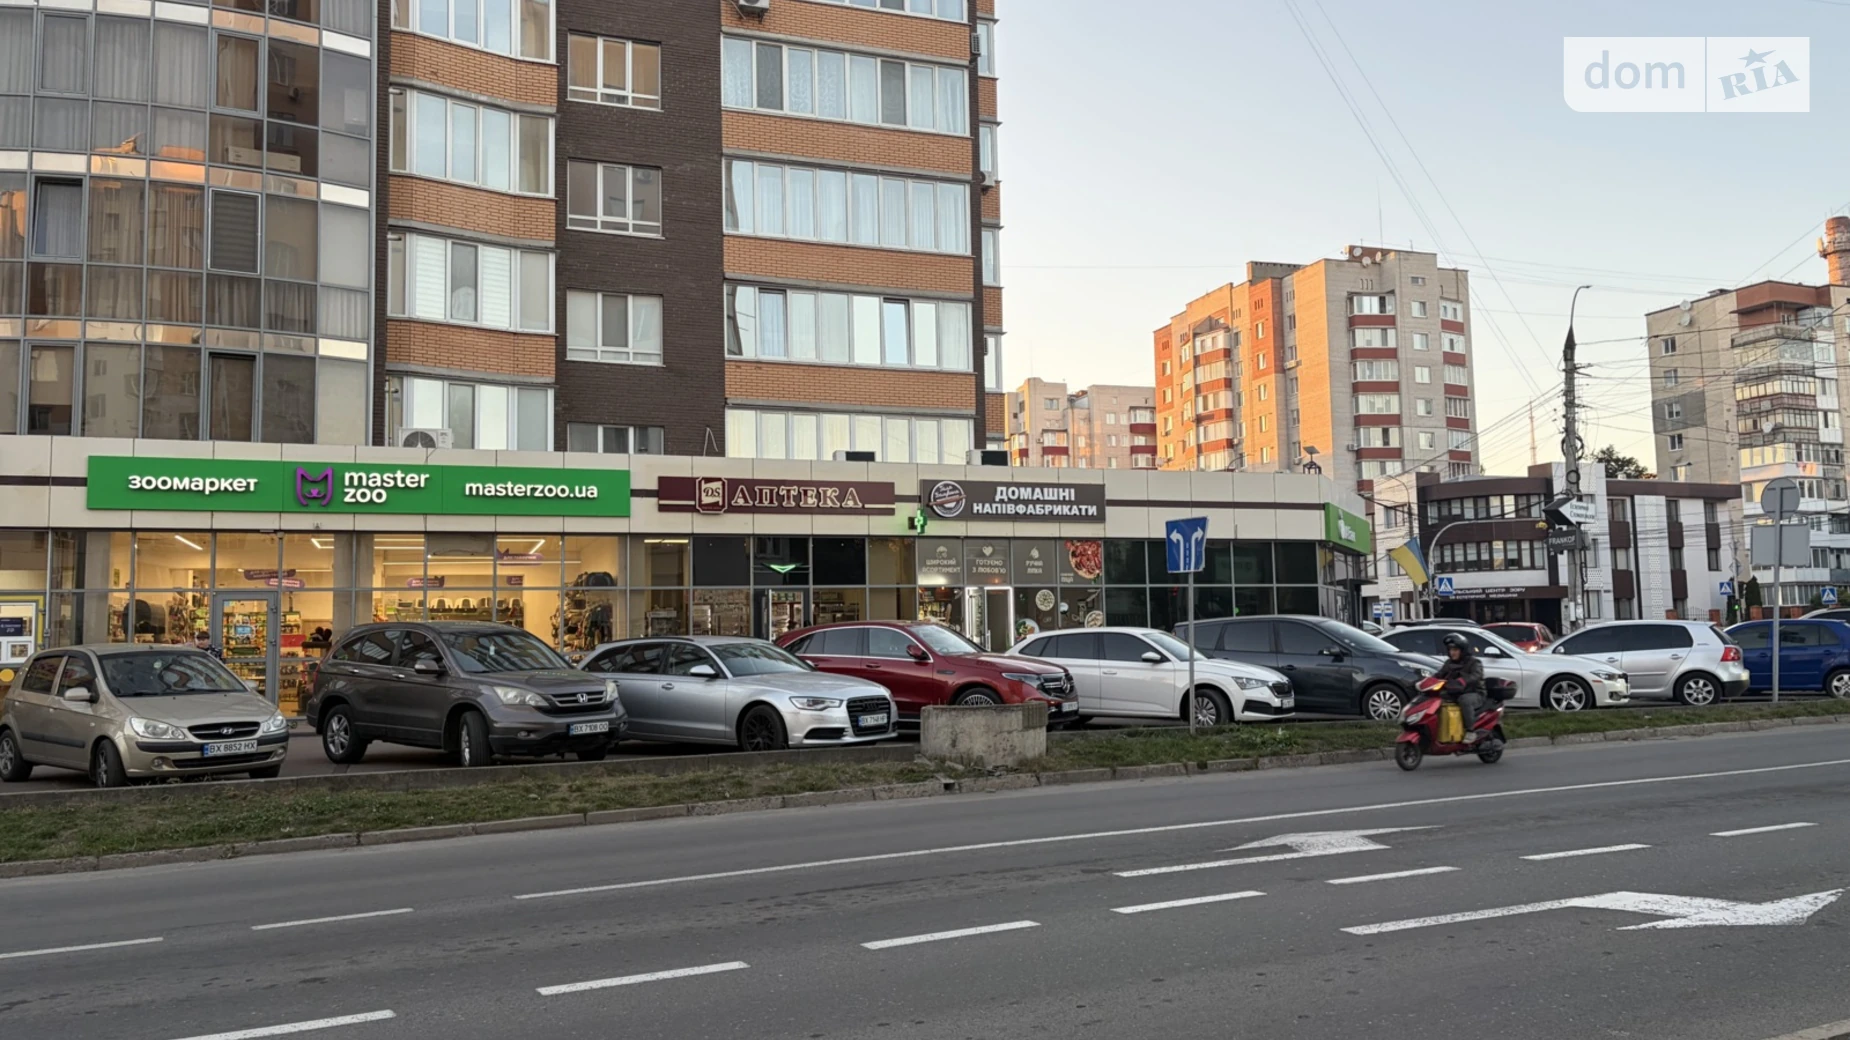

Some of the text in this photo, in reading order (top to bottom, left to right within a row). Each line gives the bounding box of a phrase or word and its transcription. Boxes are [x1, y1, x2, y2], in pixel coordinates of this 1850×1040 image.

[128, 475, 258, 495] зоомаркет
[344, 470, 429, 488] master
[343, 488, 388, 503] zoo
[465, 481, 598, 499] masterzoo.ua
[731, 485, 862, 508] АПТЕКА
[995, 487, 1075, 502] ДОМАШНІ
[973, 503, 1097, 516] НАПІВФАБРИКАТИ
[926, 558, 957, 566] ШИРОКИЙ
[975, 559, 1004, 567] ГОТУЄМО
[922, 566, 962, 574] АСОРТИМЕНТ
[209, 741, 256, 754] BX 8852 HX
